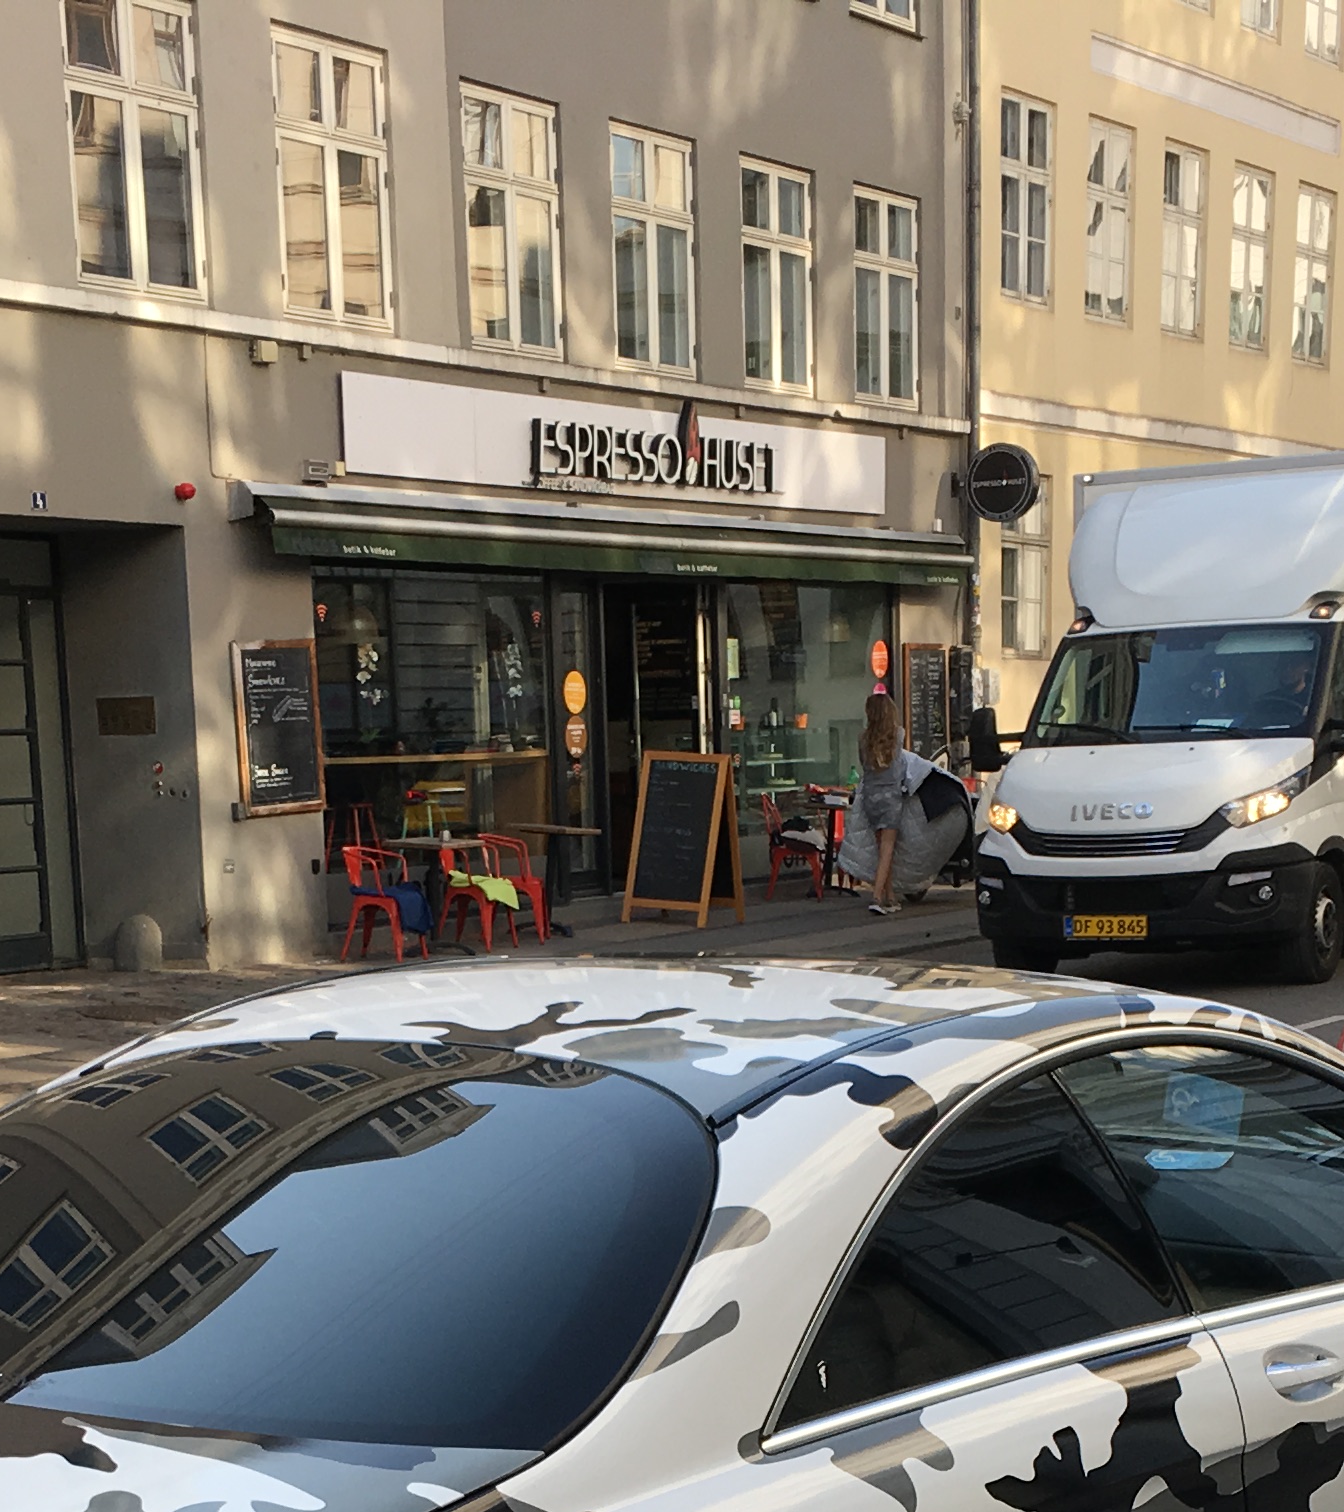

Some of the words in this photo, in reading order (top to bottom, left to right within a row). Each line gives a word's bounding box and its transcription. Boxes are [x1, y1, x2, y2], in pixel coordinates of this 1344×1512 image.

[538, 419, 683, 484] ESPRESSO
[703, 436, 784, 493] HUSET
[1070, 803, 1154, 822] IVECO
[1074, 919, 1093, 934] DF
[1096, 919, 1114, 934] 93
[1117, 919, 1145, 934] 845
